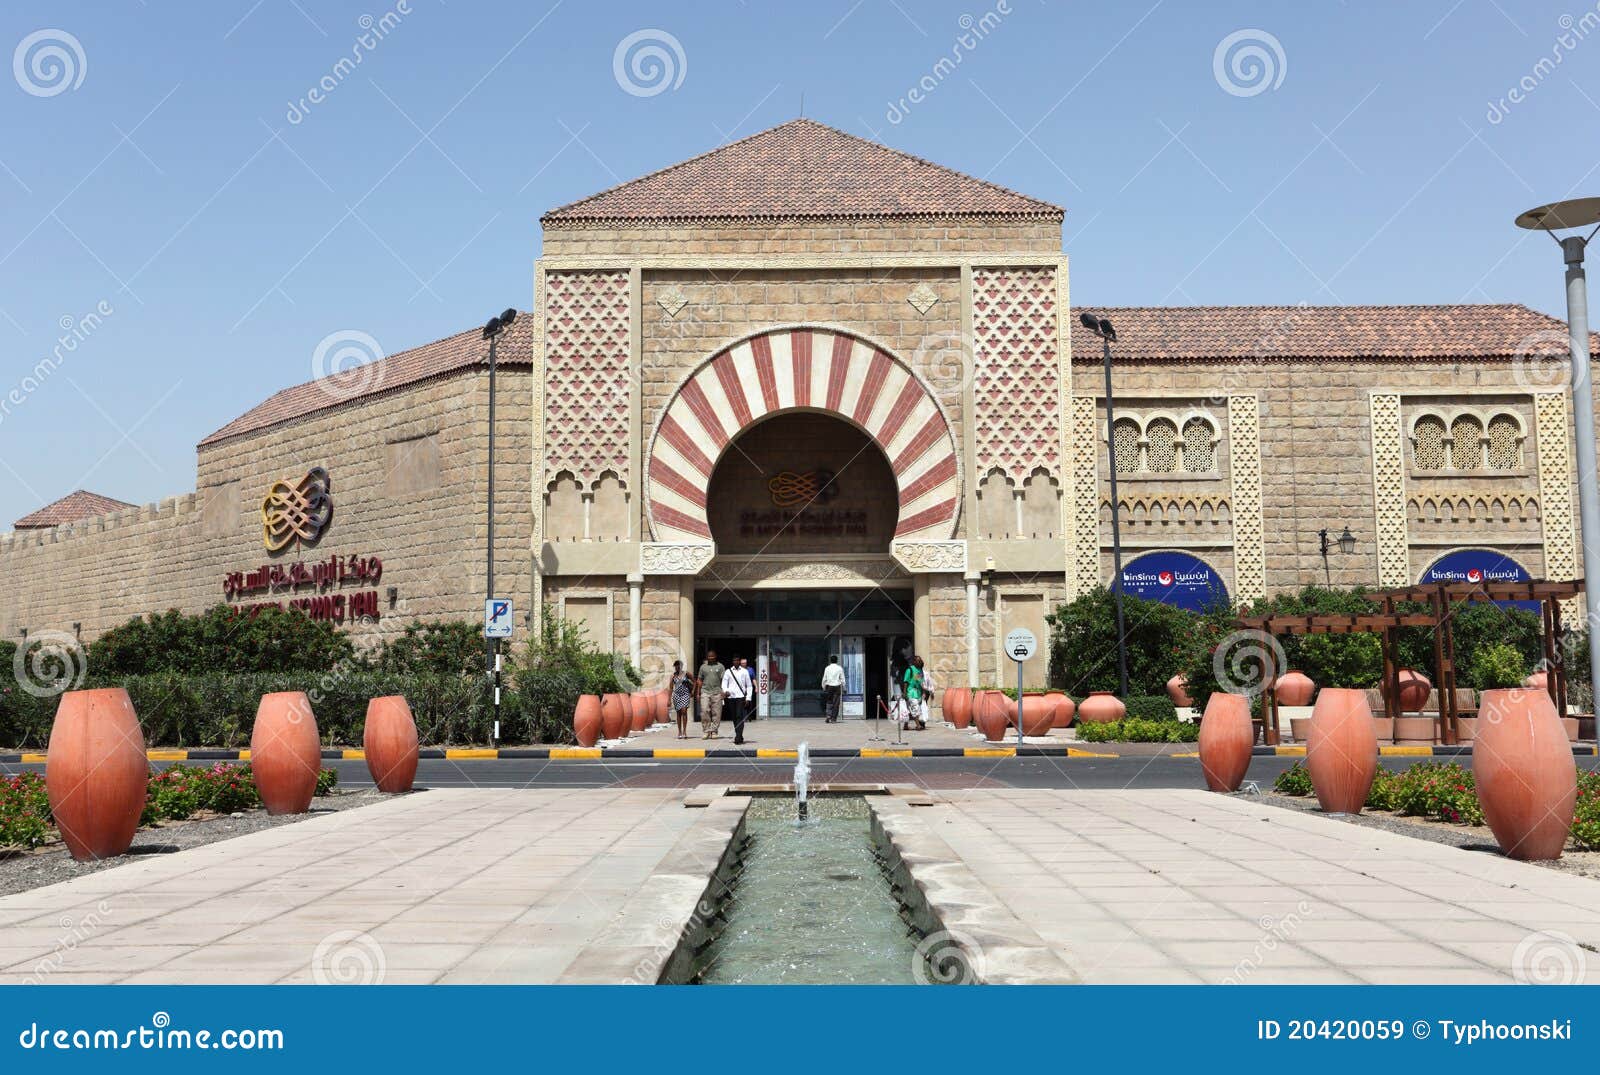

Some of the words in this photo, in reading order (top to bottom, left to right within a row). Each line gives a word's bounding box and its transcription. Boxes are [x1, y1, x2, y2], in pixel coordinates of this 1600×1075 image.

[1123, 571, 1157, 581] binSina
[1431, 569, 1465, 579] binSina
[493, 602, 508, 623] P
